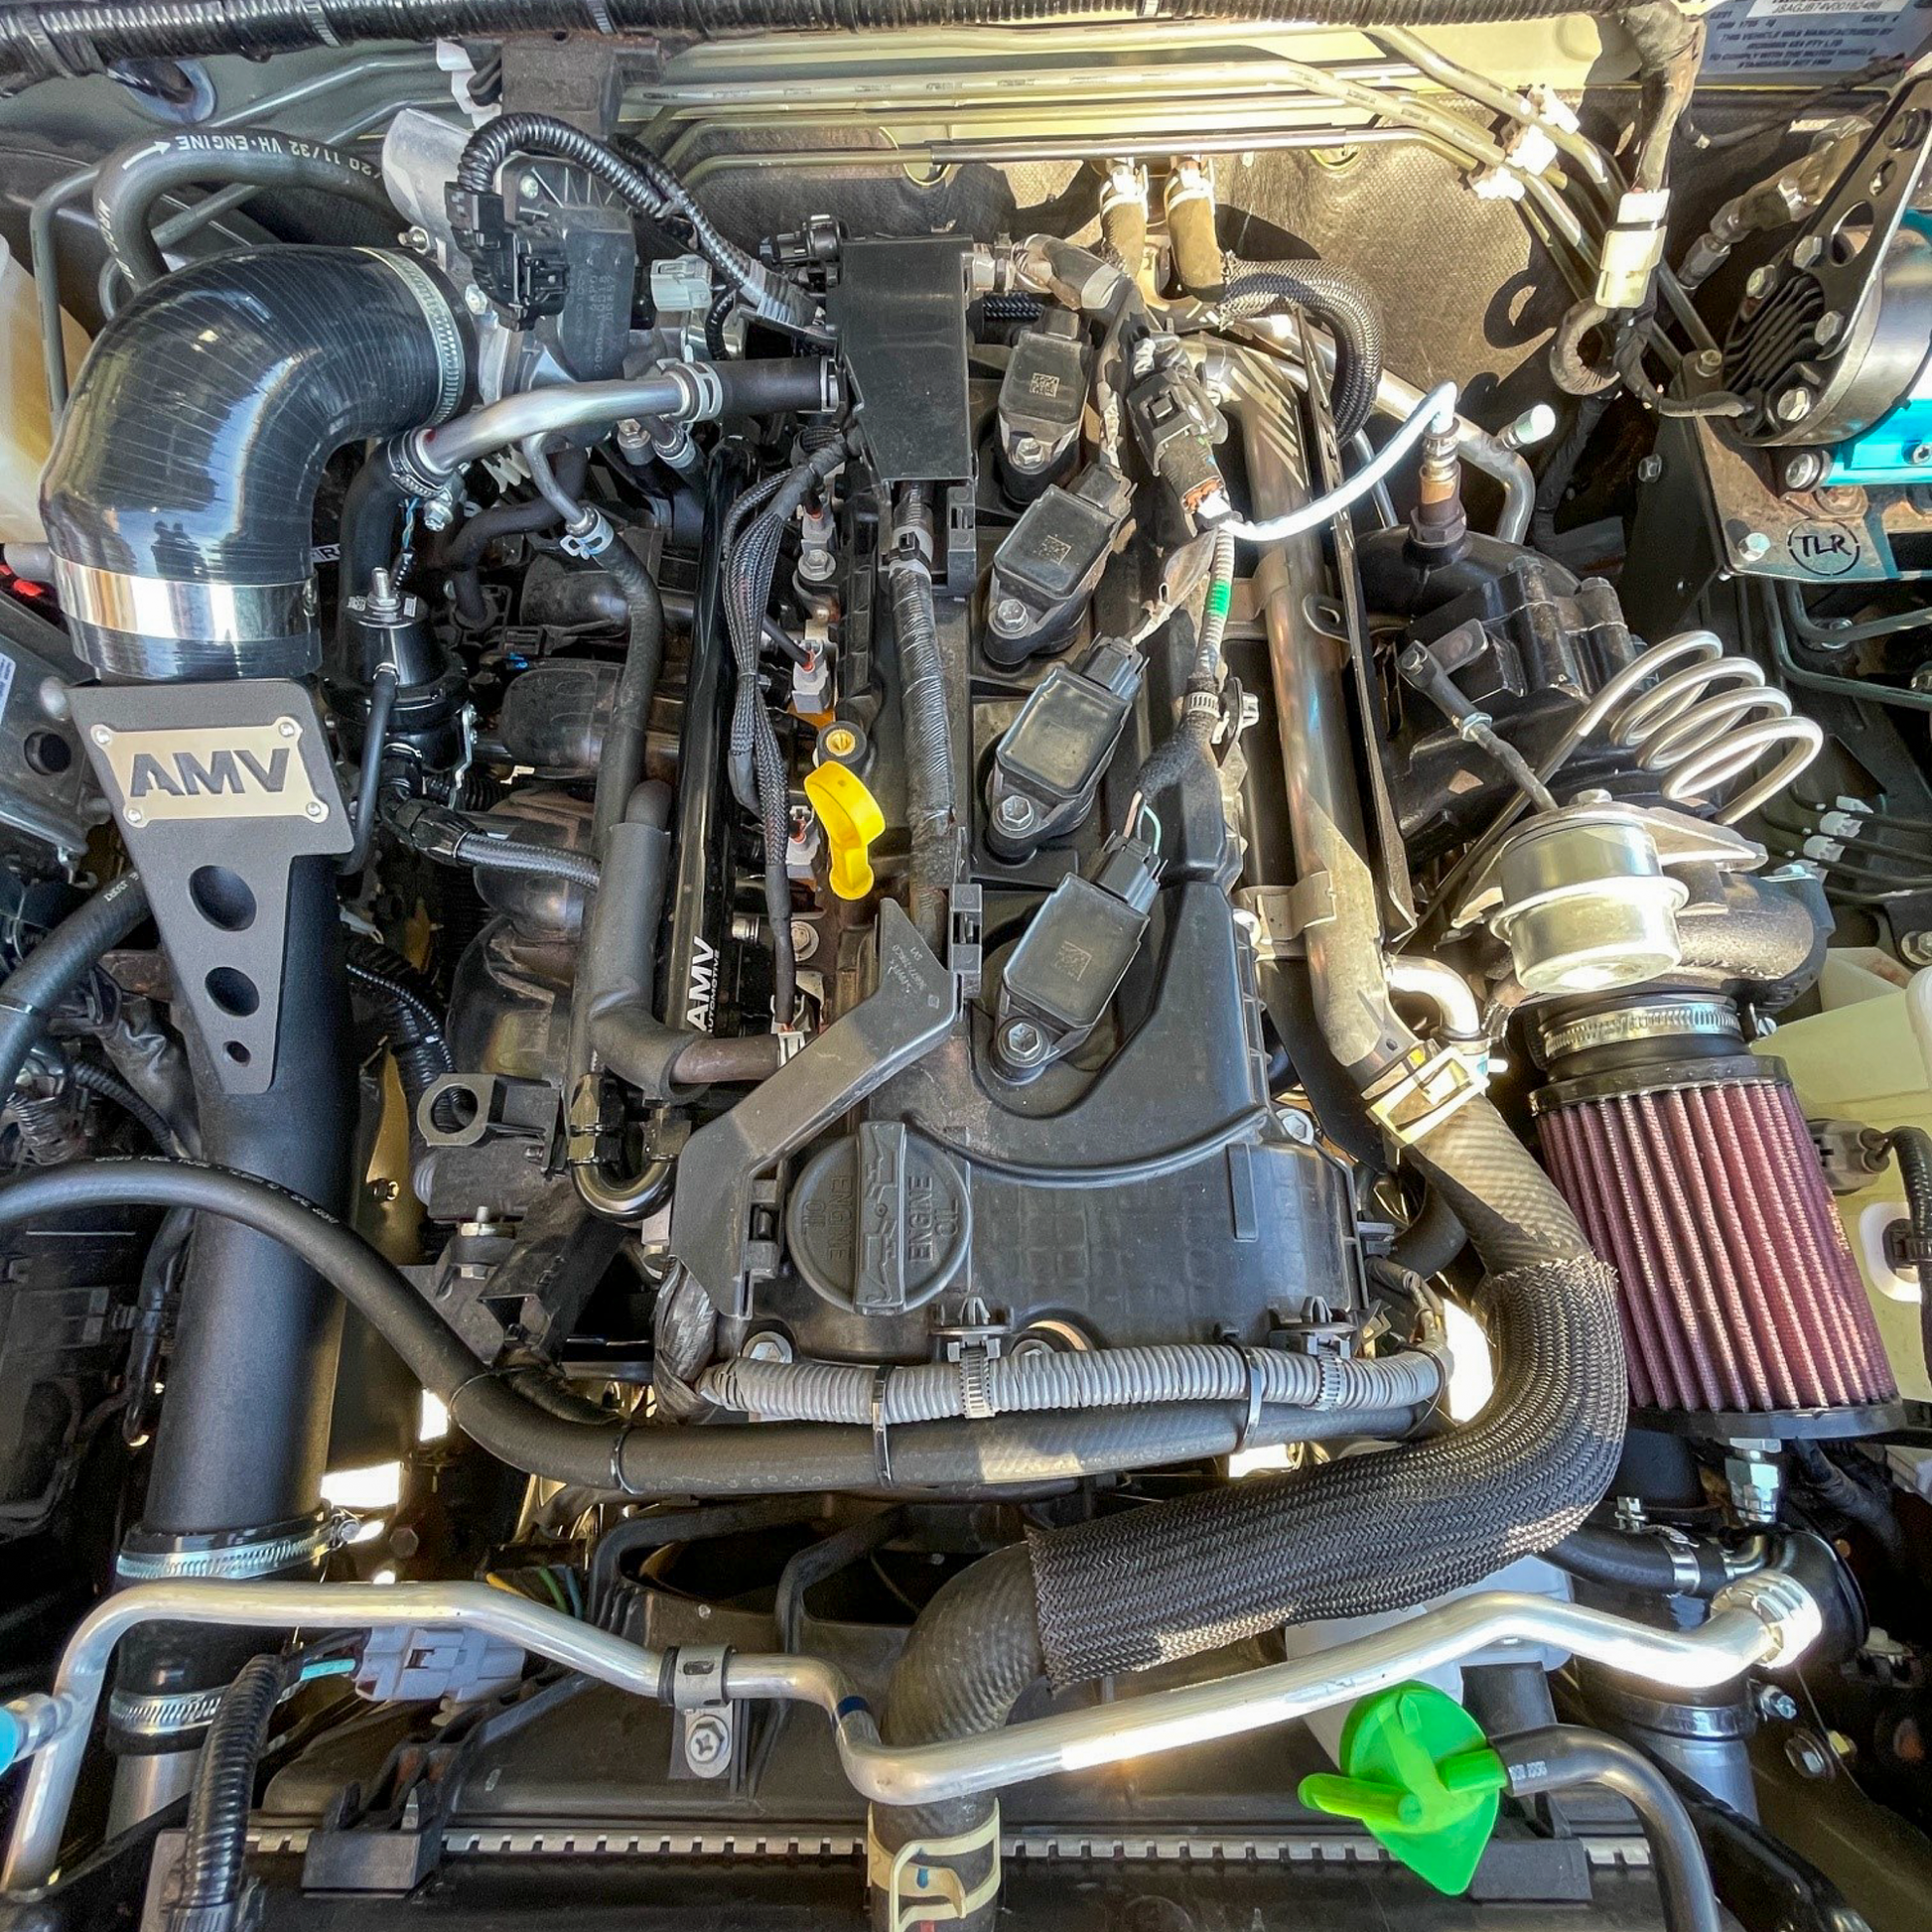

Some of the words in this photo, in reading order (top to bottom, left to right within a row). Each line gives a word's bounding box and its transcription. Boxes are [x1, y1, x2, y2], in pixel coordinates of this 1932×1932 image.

[1795, 534, 1853, 557] TLR
[130, 748, 290, 797] AMV
[686, 935, 714, 1032] AMV
[828, 1175, 853, 1261] ENGINE
[907, 1175, 933, 1262] ENGINE
[934, 1198, 959, 1237] OIL
